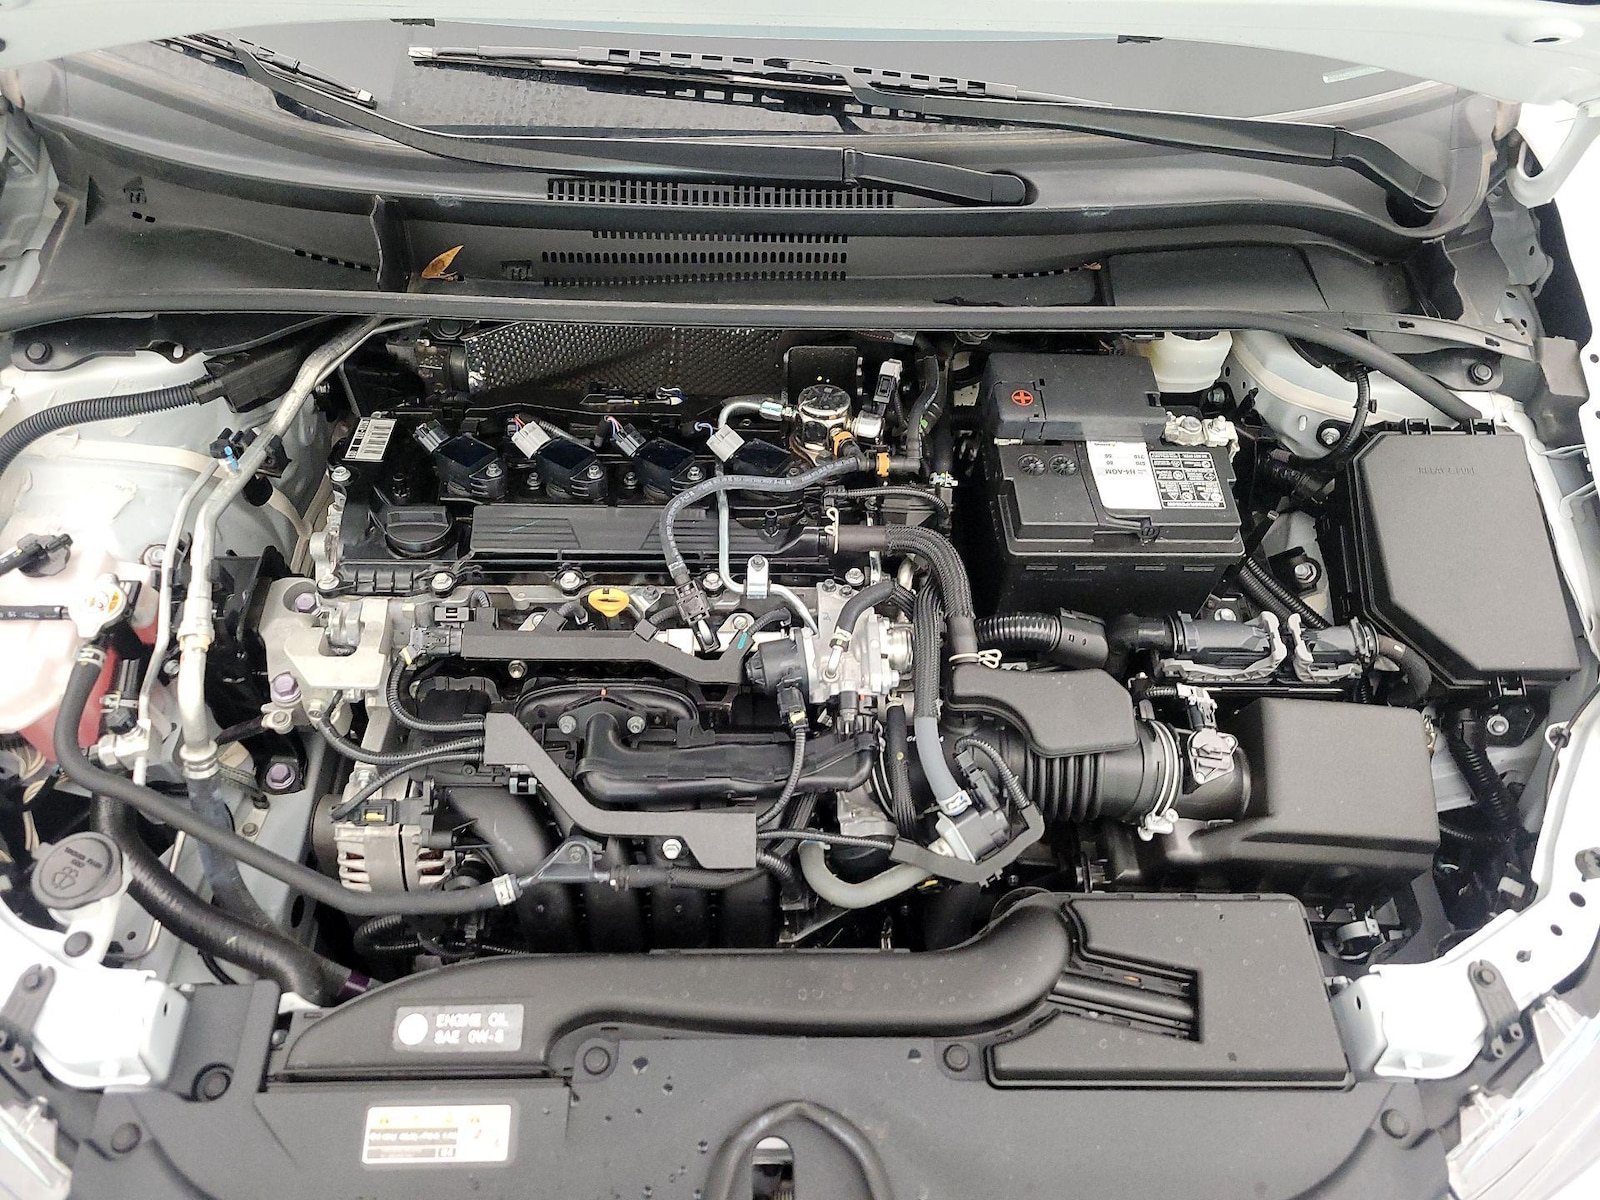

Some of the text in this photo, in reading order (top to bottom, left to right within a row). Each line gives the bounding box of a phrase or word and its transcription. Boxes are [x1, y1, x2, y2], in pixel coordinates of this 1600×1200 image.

[1105, 468, 1136, 476] H4-AGM
[435, 1011, 509, 1029] ENGINE OIL
[433, 1029, 461, 1045] SAE
